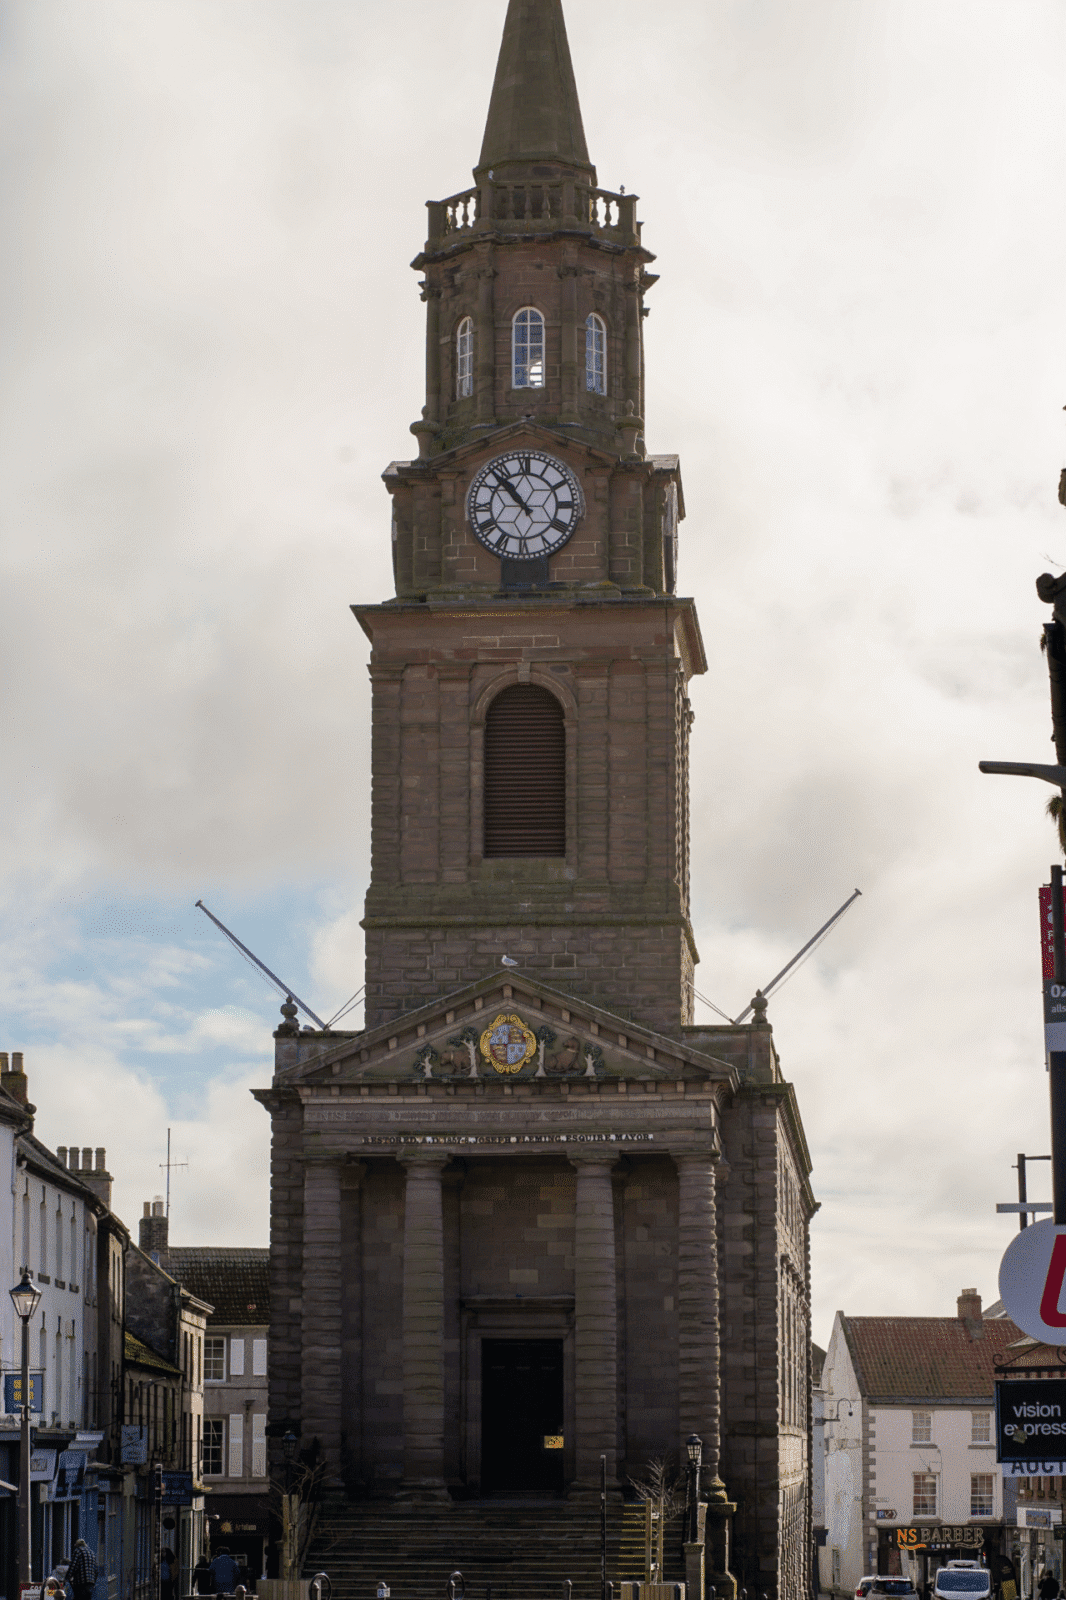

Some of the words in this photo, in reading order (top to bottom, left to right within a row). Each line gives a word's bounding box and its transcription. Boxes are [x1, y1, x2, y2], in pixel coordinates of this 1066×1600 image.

[473, 1135, 511, 1144] JOSEPH
[1012, 1401, 1062, 1418] vision
[896, 1528, 917, 1543] NS
[920, 1527, 984, 1543] BARBER
